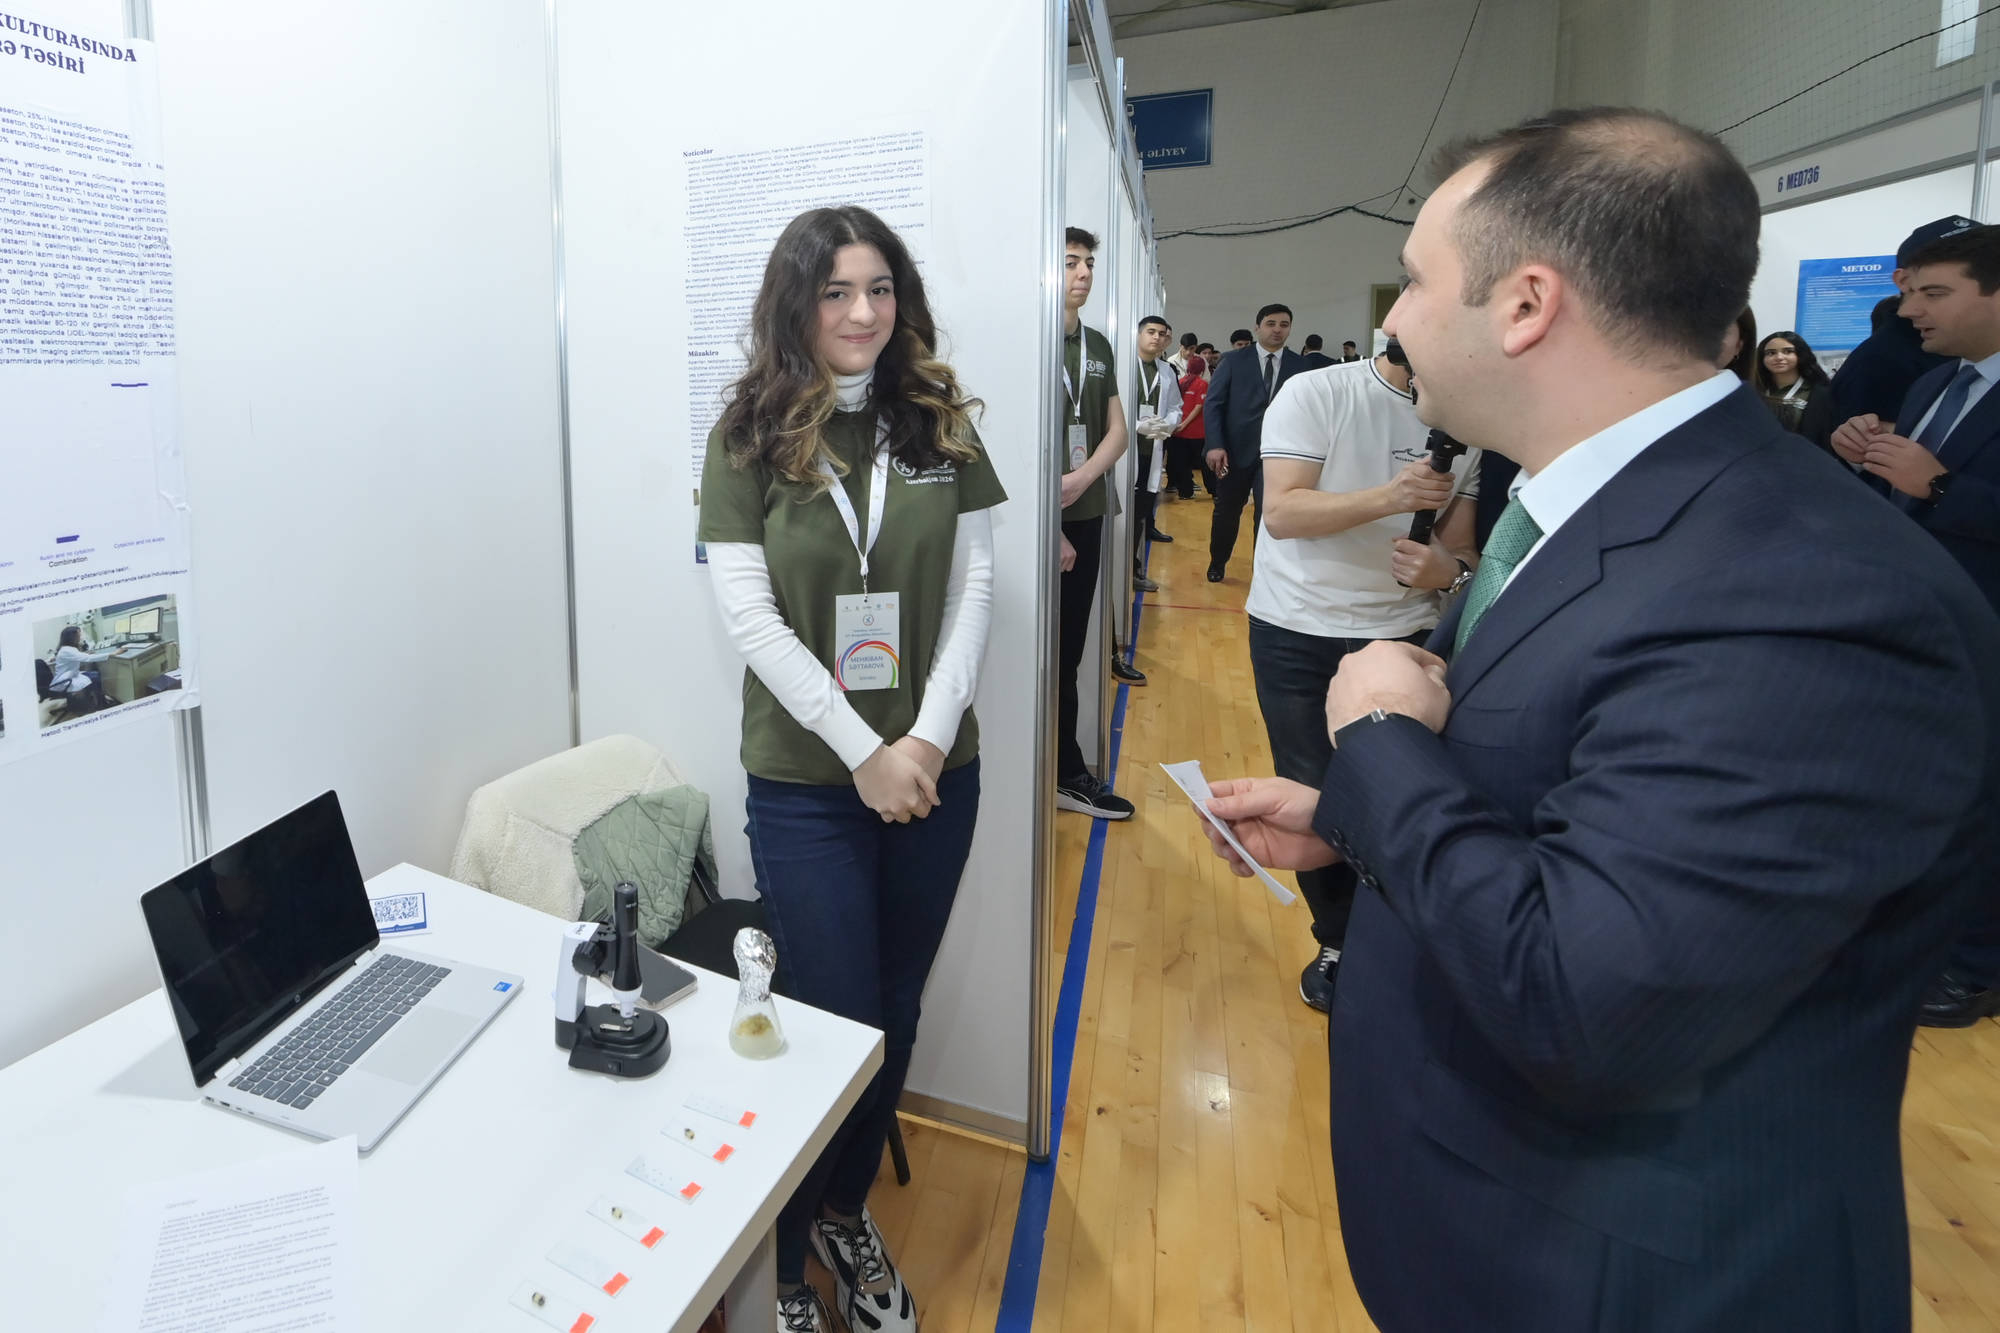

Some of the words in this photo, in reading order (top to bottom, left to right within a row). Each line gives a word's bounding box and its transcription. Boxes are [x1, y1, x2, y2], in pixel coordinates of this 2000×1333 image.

[21, 45, 85, 74] TƏSİRİ
[1147, 146, 1187, 159] ƏLİYEV
[1777, 176, 1784, 192] 6
[1786, 165, 1820, 191] MED736
[1841, 264, 1882, 273] METOD
[48, 556, 88, 568] Combination
